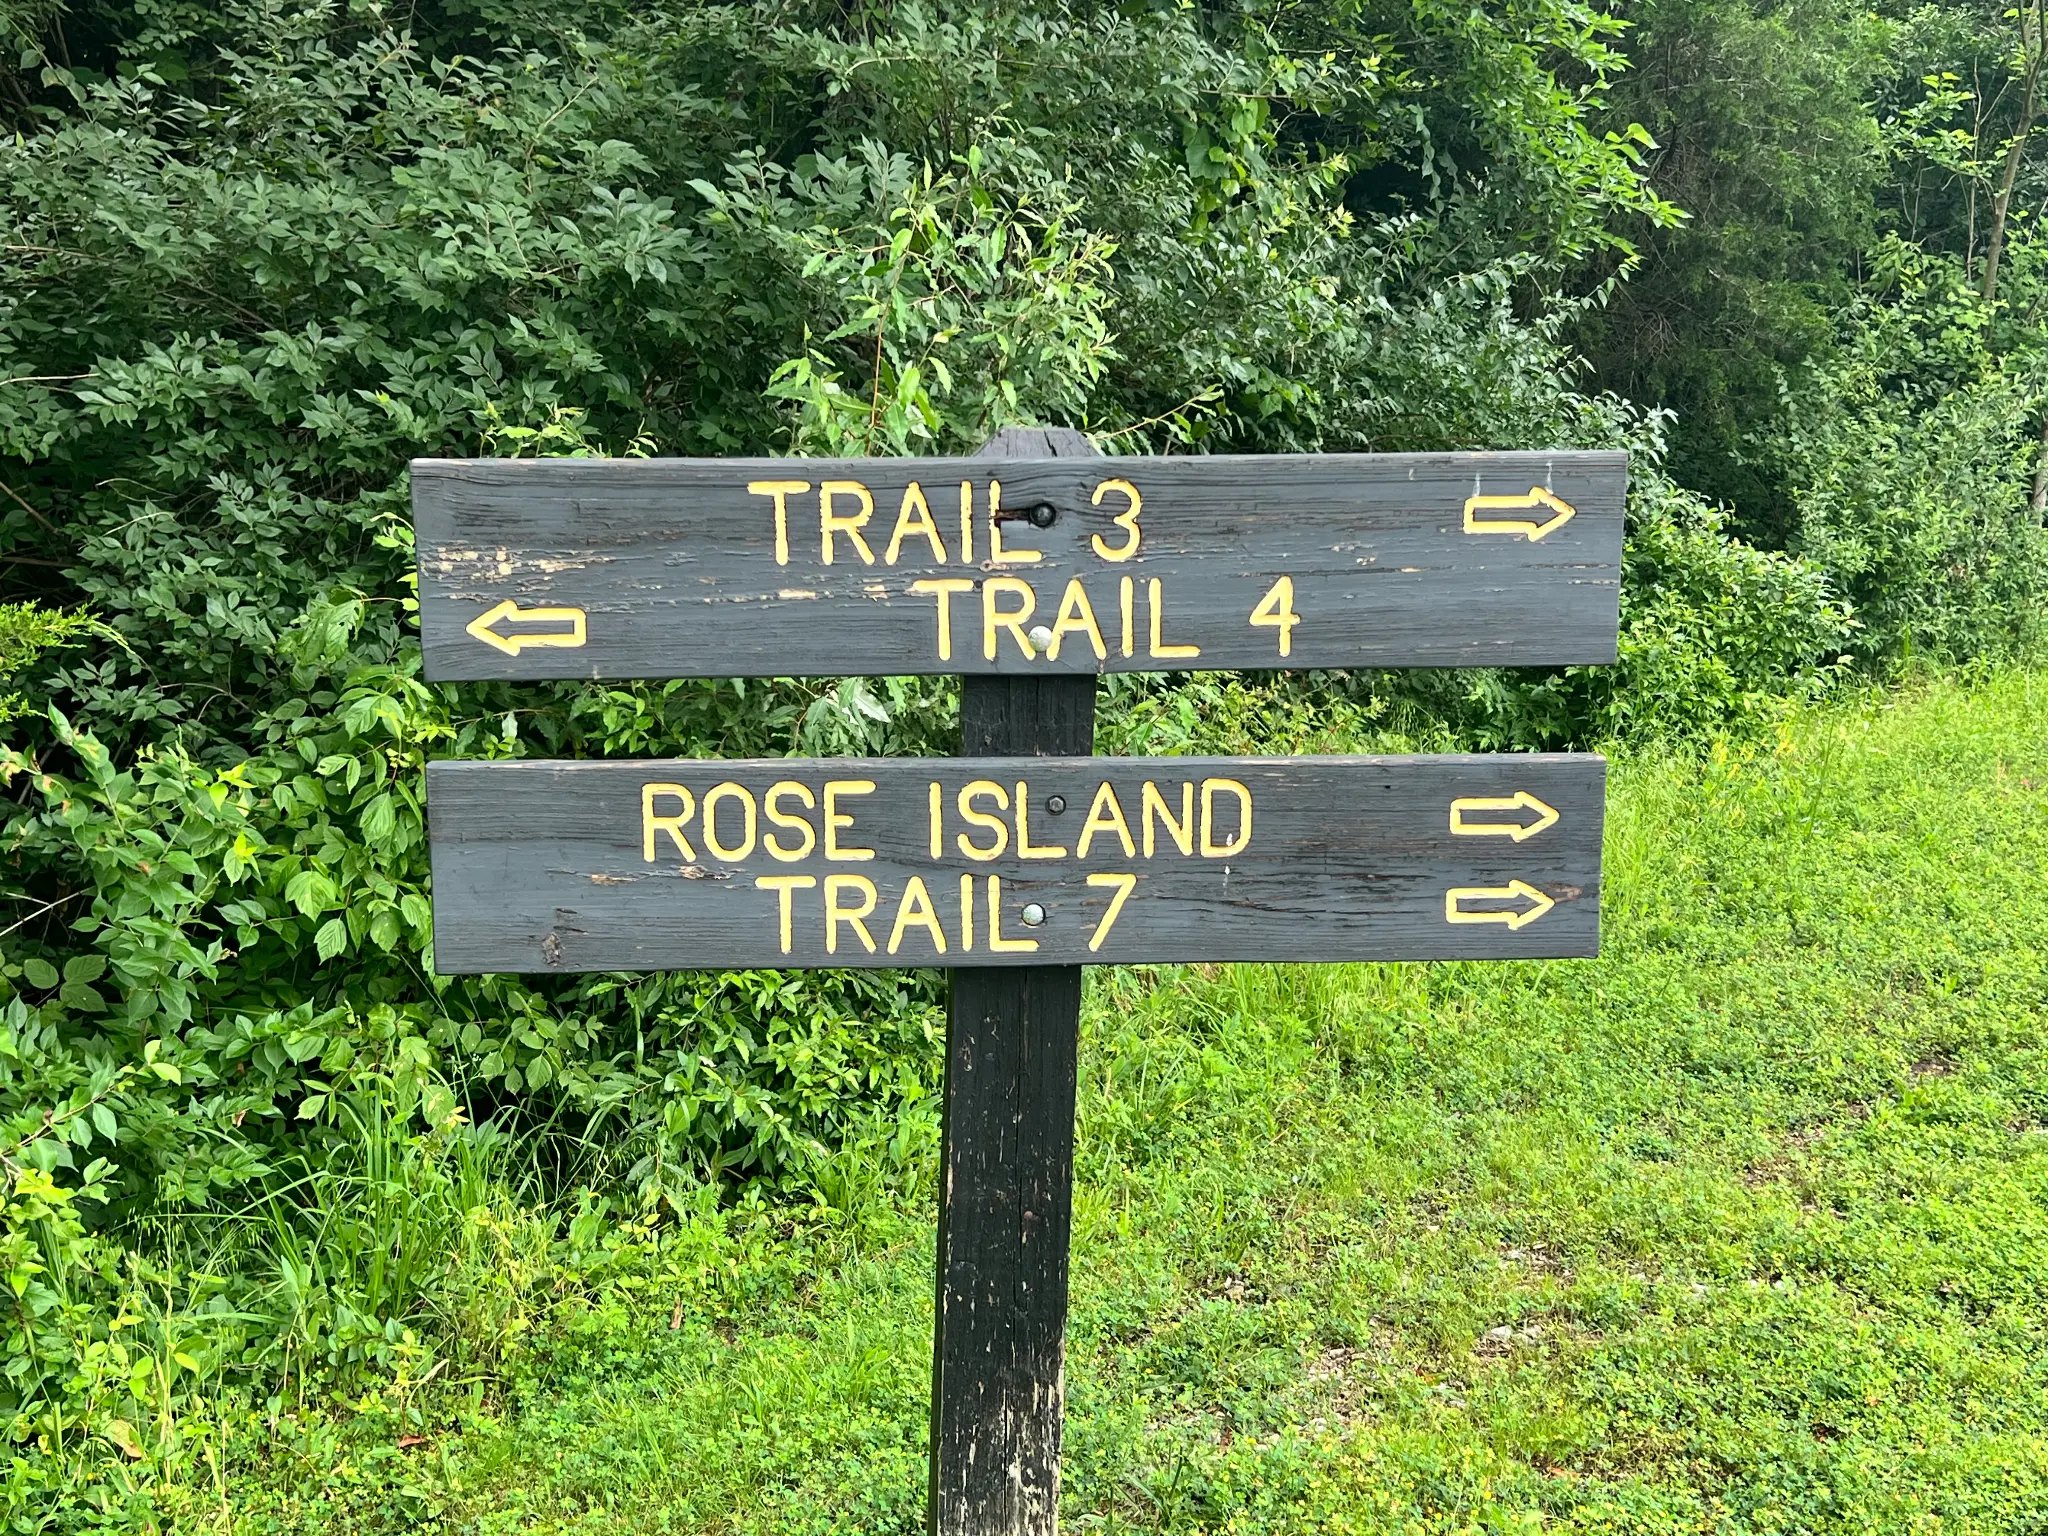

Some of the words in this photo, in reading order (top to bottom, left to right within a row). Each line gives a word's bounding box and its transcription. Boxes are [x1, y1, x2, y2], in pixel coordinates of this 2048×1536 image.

[747, 480, 1043, 566] TRAIL
[1091, 478, 1142, 562] 3
[913, 576, 1200, 661] TRAIL
[1249, 575, 1301, 657] 4
[641, 780, 877, 863] ROSE
[929, 778, 1253, 861] ISLAND
[755, 873, 1040, 954] TRAIL
[1086, 873, 1137, 951] 7
